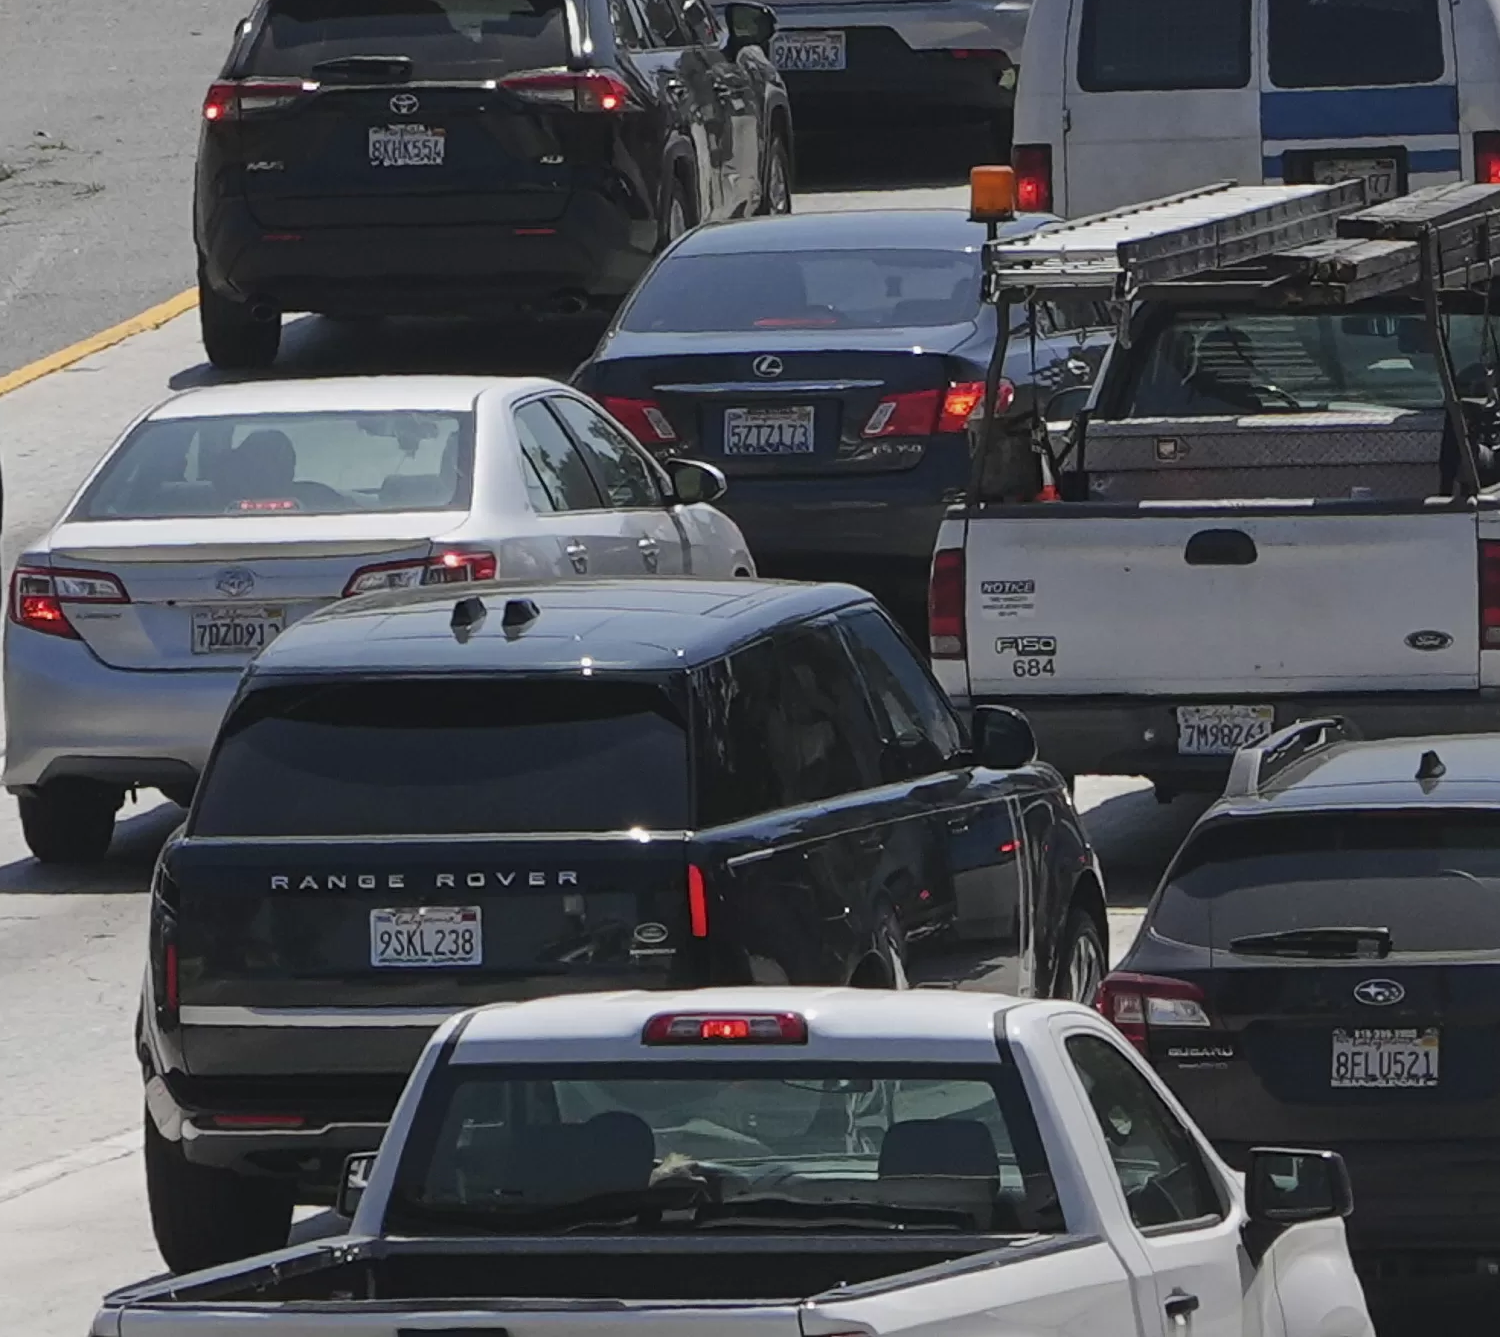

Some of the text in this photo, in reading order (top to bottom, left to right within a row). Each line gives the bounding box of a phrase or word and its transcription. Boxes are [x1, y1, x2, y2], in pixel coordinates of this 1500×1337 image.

[775, 44, 841, 62] 9AXY543
[371, 136, 443, 160] 8KHK554
[982, 580, 1036, 594] NOTICE
[1012, 658, 1057, 678] 684
[270, 870, 578, 890] RANGE ROVER
[379, 927, 475, 958] 9SKL238
[1167, 1046, 1236, 1058] SUBARU
[1335, 1051, 1435, 1080] 8FLU521
